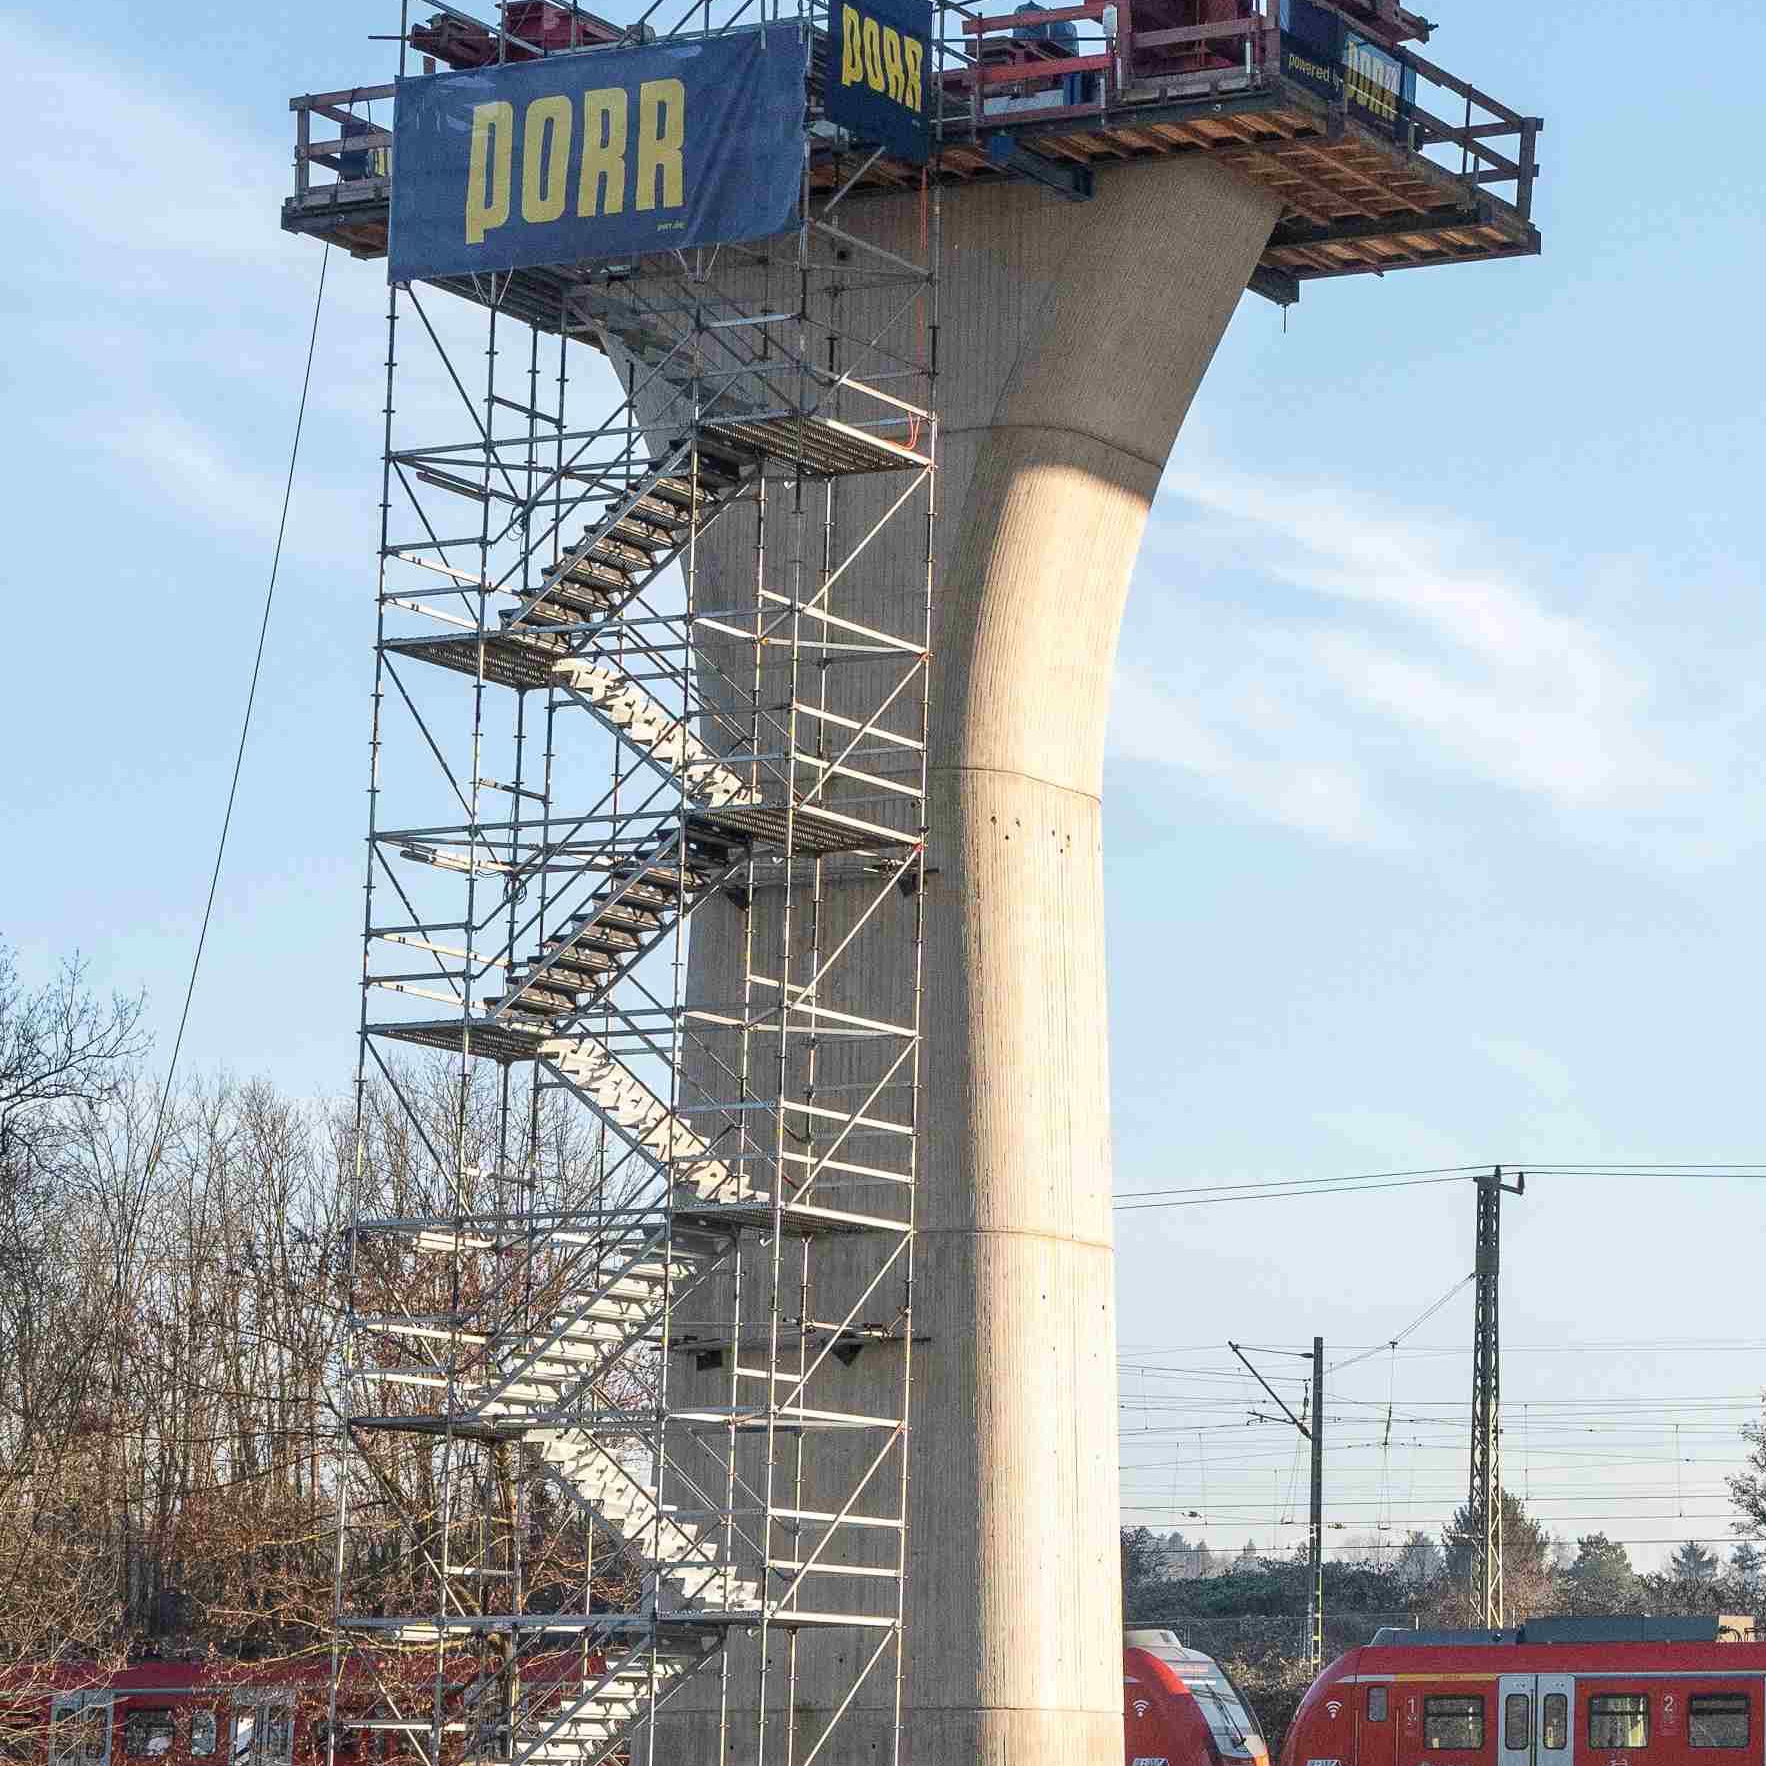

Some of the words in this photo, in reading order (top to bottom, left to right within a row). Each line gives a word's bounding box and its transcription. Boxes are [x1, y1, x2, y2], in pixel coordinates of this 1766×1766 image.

[841, 3, 923, 113] PORR
[1289, 54, 1330, 82] powered
[466, 79, 684, 245] PORR
[1663, 1695, 1674, 1712] 2
